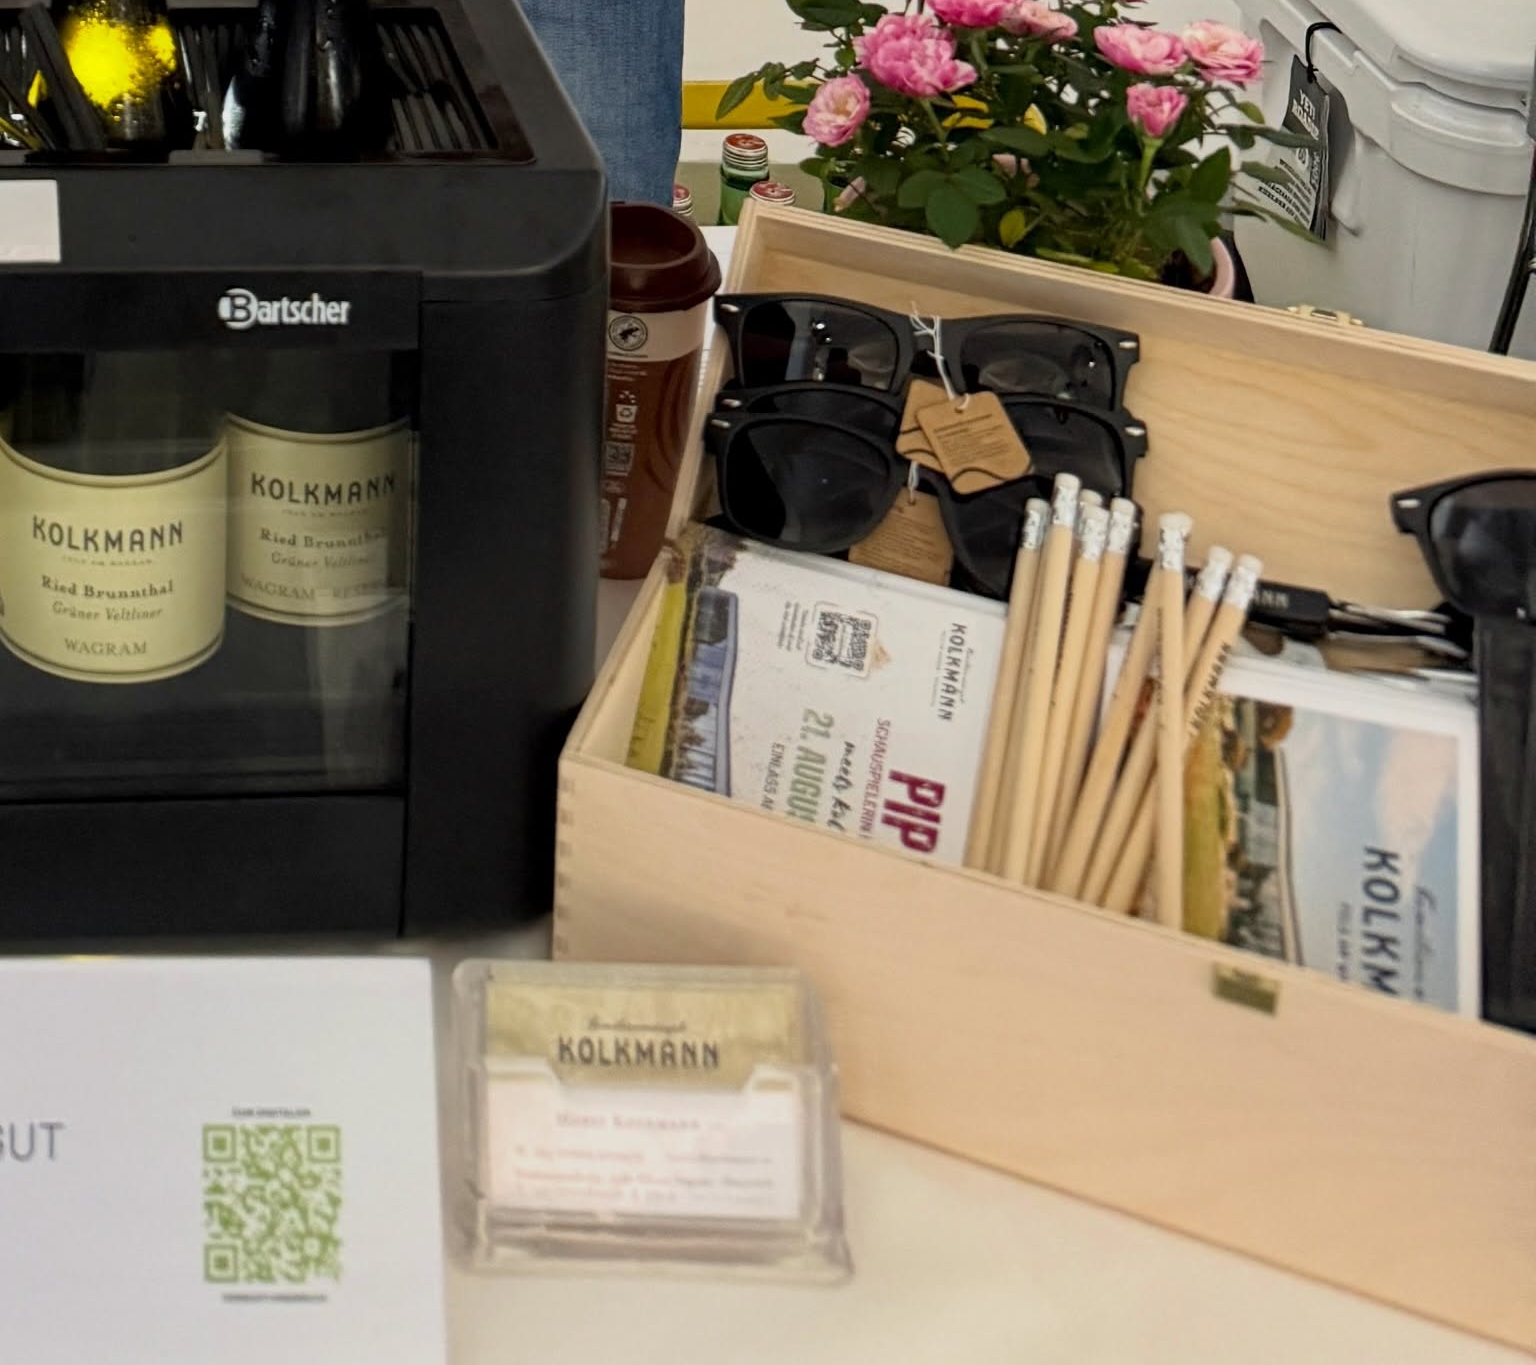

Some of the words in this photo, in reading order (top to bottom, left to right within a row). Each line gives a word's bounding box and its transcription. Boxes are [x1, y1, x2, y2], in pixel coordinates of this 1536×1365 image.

[218, 288, 351, 329] Bartscher
[252, 472, 395, 505] KOLKMANN
[33, 515, 183, 553] KOLKMANN
[42, 575, 77, 596] Ried
[84, 579, 173, 599] Brunnthal
[53, 601, 99, 620] Grüner
[64, 638, 147, 656] WAGRAM
[938, 622, 967, 720] KOLKMANN
[881, 770, 946, 854] PIP
[557, 1036, 720, 1068] KOLKMANN
